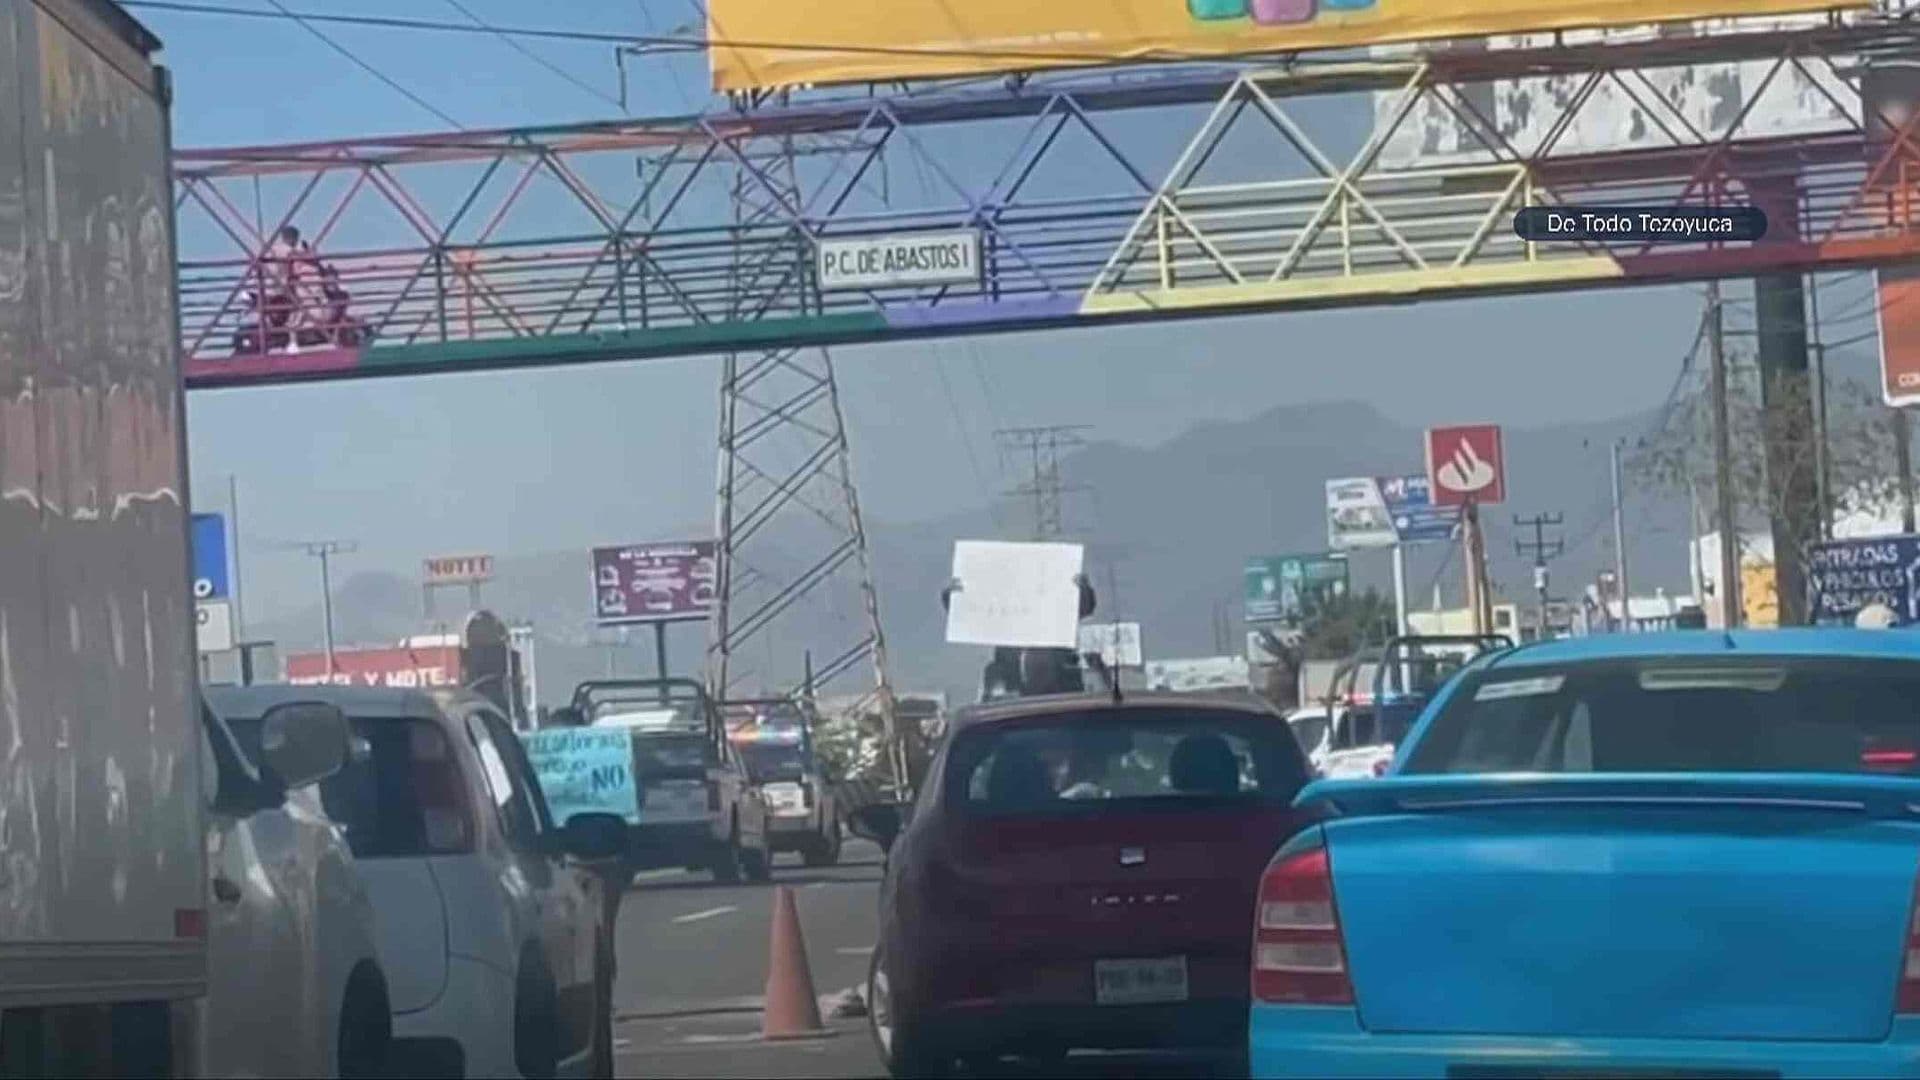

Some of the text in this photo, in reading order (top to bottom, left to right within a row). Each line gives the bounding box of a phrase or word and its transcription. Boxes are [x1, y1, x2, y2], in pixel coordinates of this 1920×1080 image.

[884, 244, 961, 272] ABASTOS
[429, 556, 487, 575] MOTEL
[592, 765, 625, 792] NO
